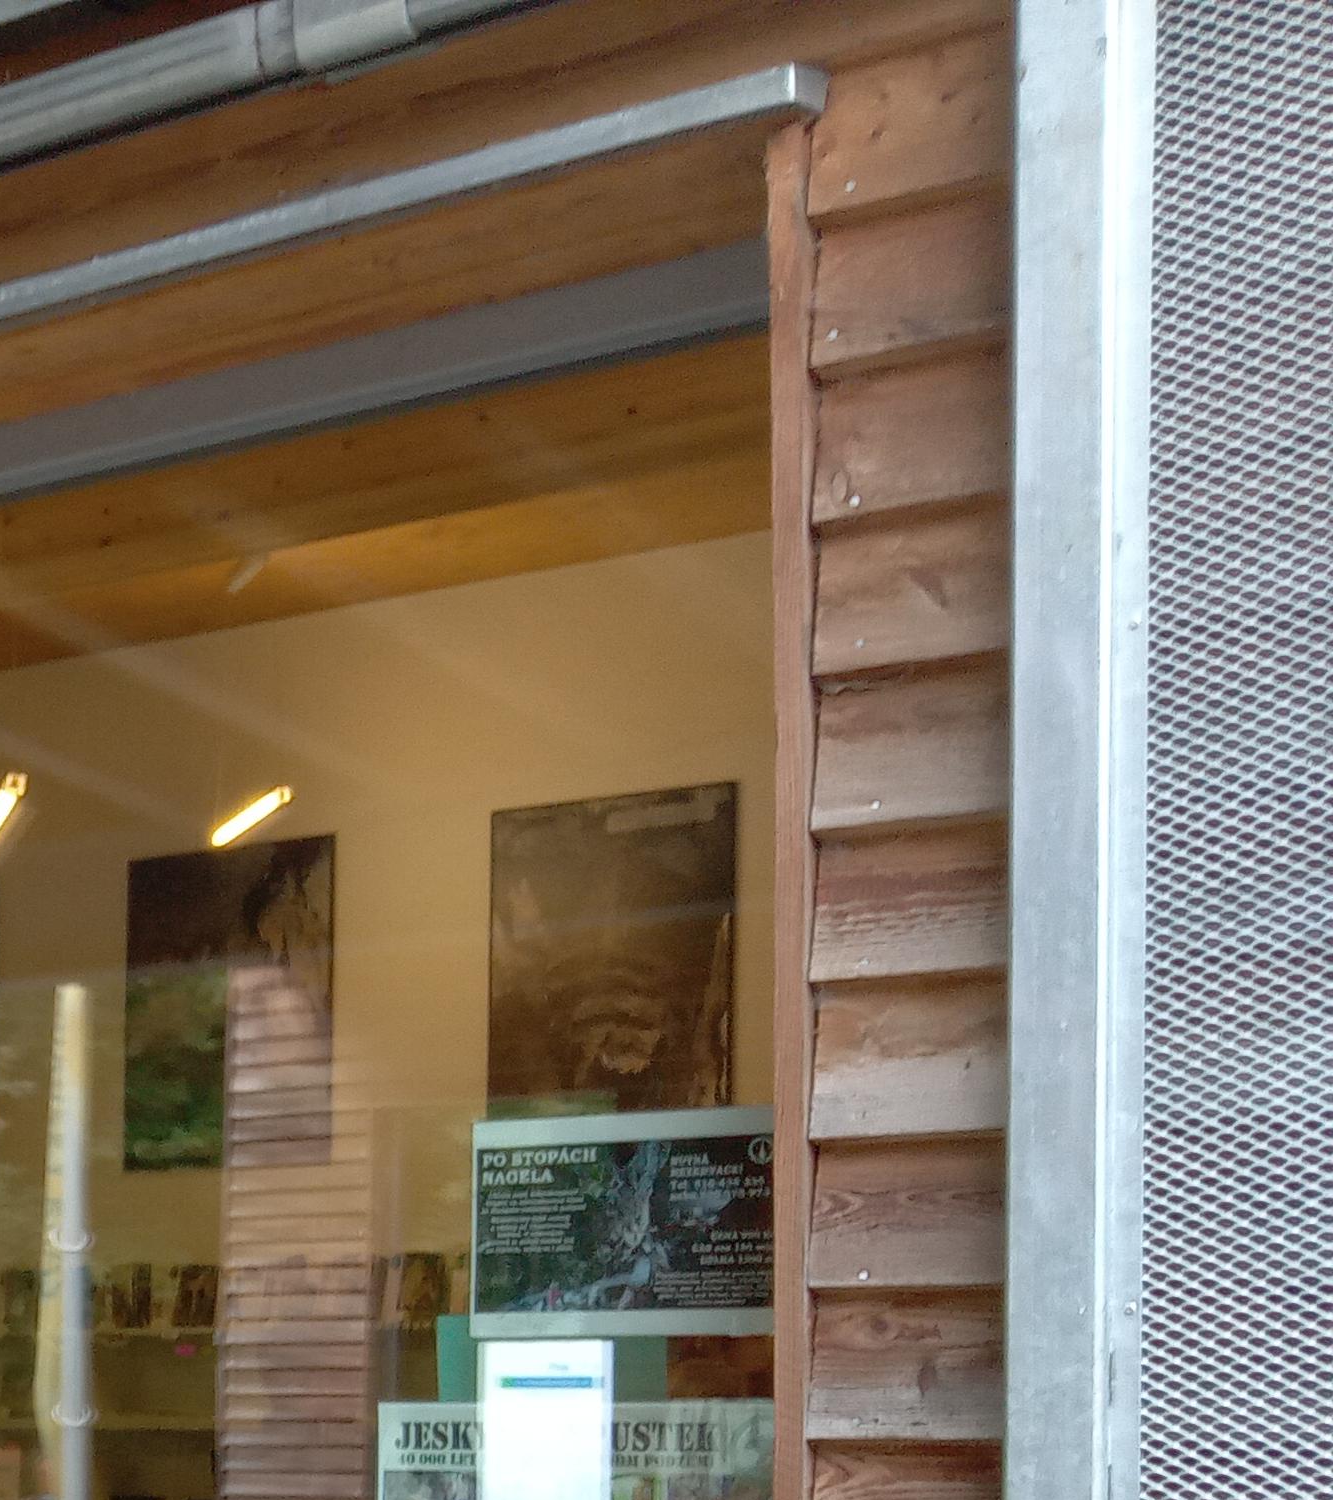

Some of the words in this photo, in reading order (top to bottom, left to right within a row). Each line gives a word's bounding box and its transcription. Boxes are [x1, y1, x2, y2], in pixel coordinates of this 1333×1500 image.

[483, 1151, 507, 1168] PO
[394, 1420, 484, 1452] JESK
[611, 1420, 715, 1453] USTEK
